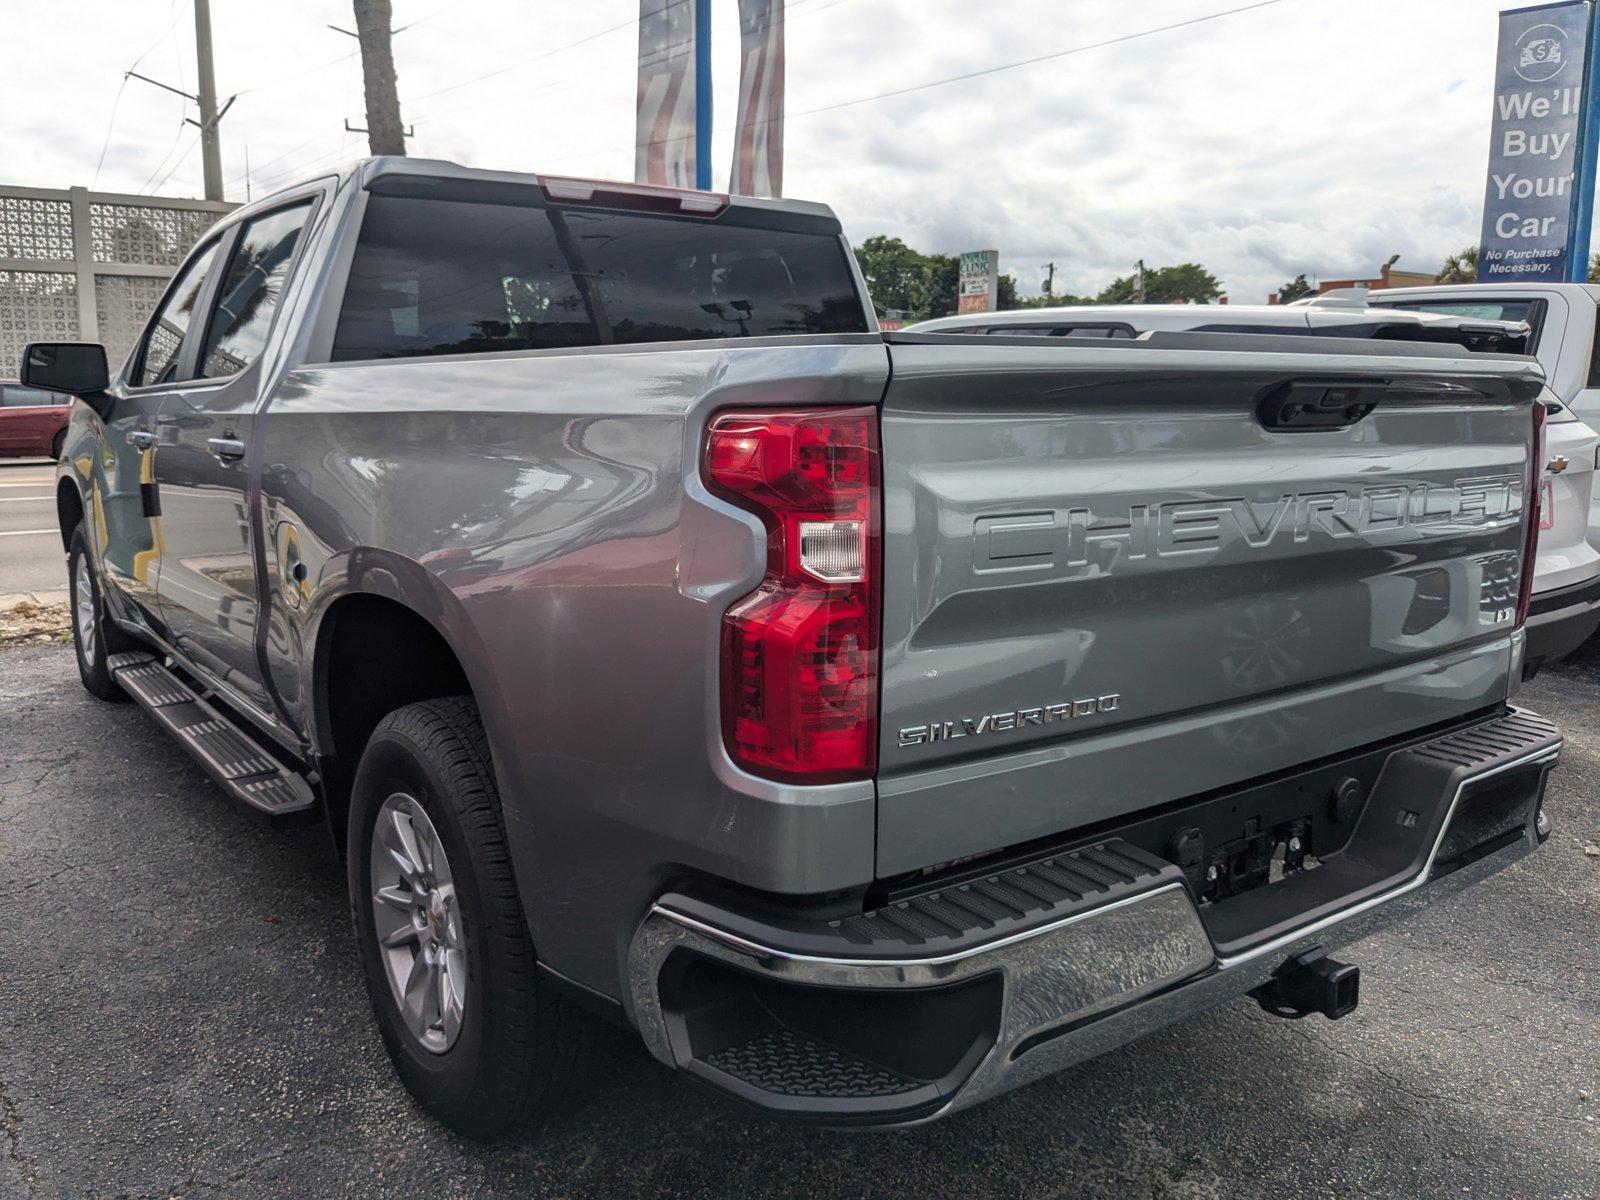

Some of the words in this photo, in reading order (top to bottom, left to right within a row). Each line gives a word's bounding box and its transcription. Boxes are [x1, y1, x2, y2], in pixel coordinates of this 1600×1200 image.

[1502, 130, 1571, 160] Buy
[1492, 173, 1571, 200] Your
[1495, 212, 1556, 239] Car
[1485, 250, 1502, 260] No
[1505, 248, 1560, 260] Purchase
[1488, 263, 1552, 274] Necessary.
[972, 473, 1522, 576] CHEVROLET
[898, 693, 1121, 748] SILVERADO
